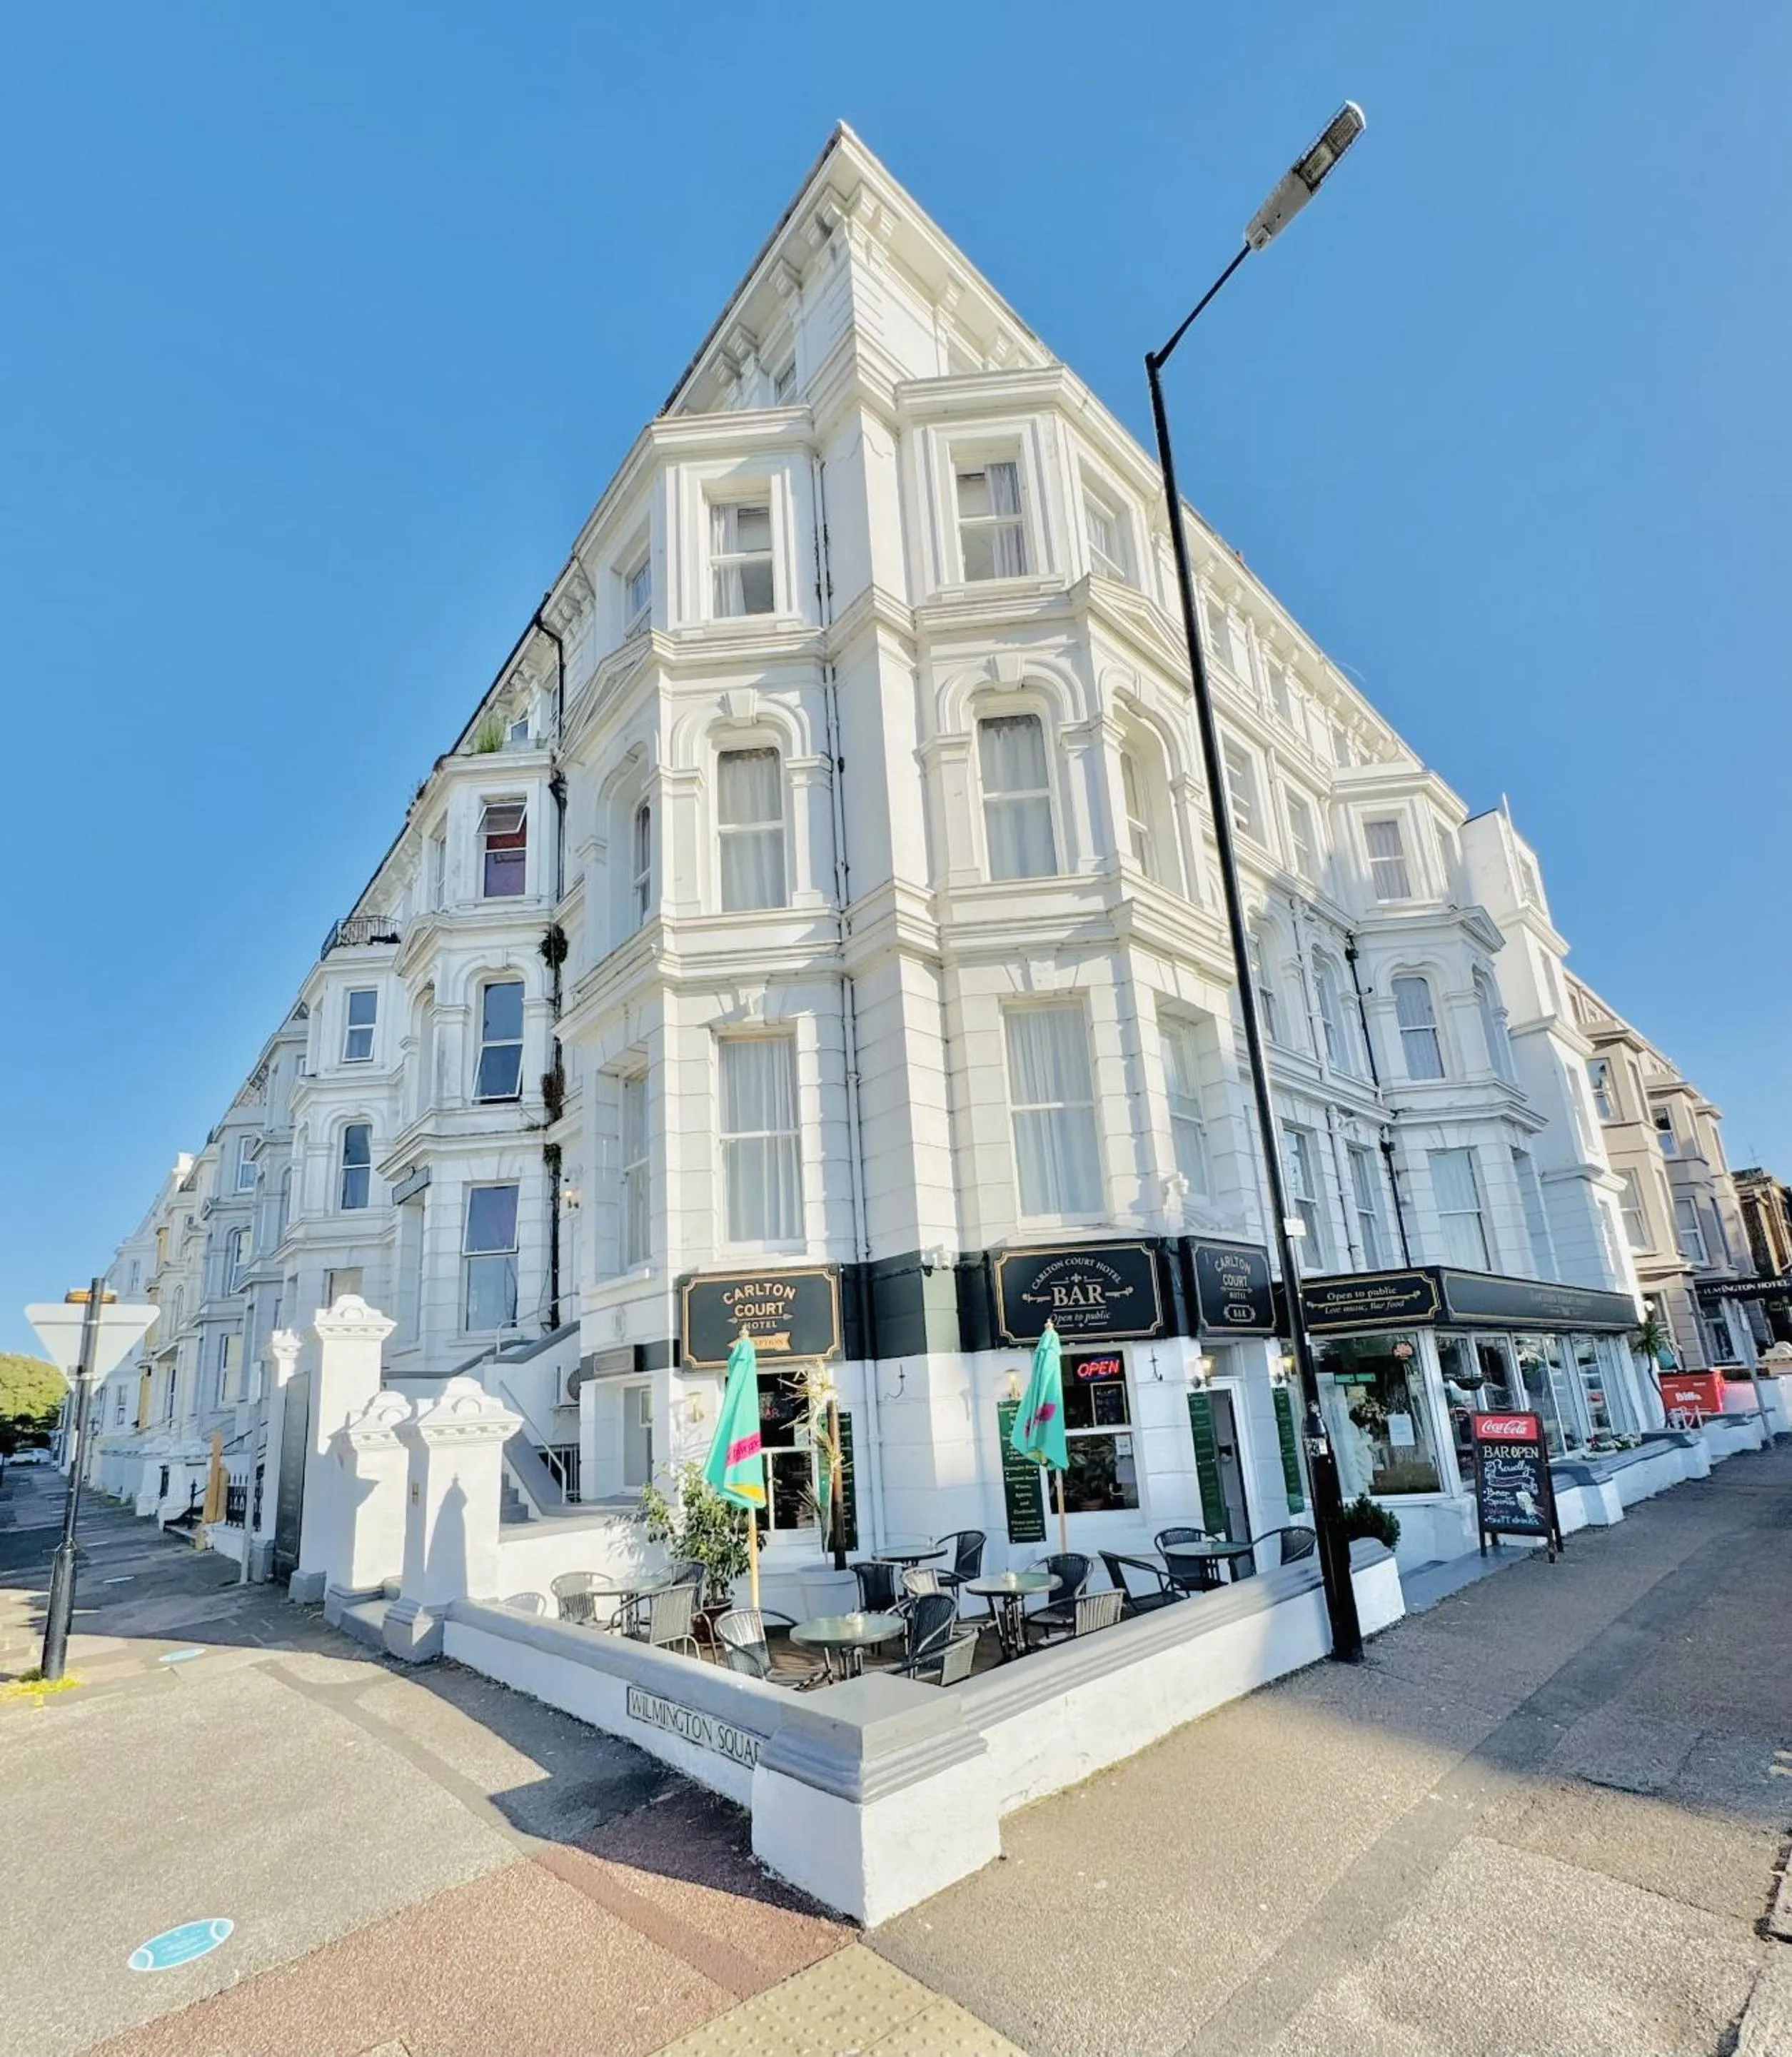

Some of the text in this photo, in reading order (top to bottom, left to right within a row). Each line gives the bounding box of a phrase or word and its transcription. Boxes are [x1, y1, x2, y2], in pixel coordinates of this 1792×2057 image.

[1214, 1256, 1251, 1274] CARLTON
[1032, 1257, 1121, 1290] CARLTON COURT HOTEL
[1222, 1274, 1248, 1287] COURT
[723, 1283, 796, 1304] CARLTON
[1327, 1292, 1352, 1302] Open
[1367, 1286, 1397, 1298] public
[1697, 1279, 1790, 1294] ILMINGTON HOTEL
[1051, 1284, 1107, 1306] BAR
[734, 1302, 785, 1317] COURT
[1386, 1299, 1405, 1311] food
[744, 1320, 777, 1329] HOTEL
[1049, 1314, 1072, 1326] Open
[1084, 1310, 1111, 1324] public
[1077, 1359, 1119, 1377] OPEN
[1482, 1445, 1539, 1458] BAR OPEN
[1486, 1487, 1510, 1497] Beer
[631, 1691, 761, 1765] WILMINGTON SQUA
